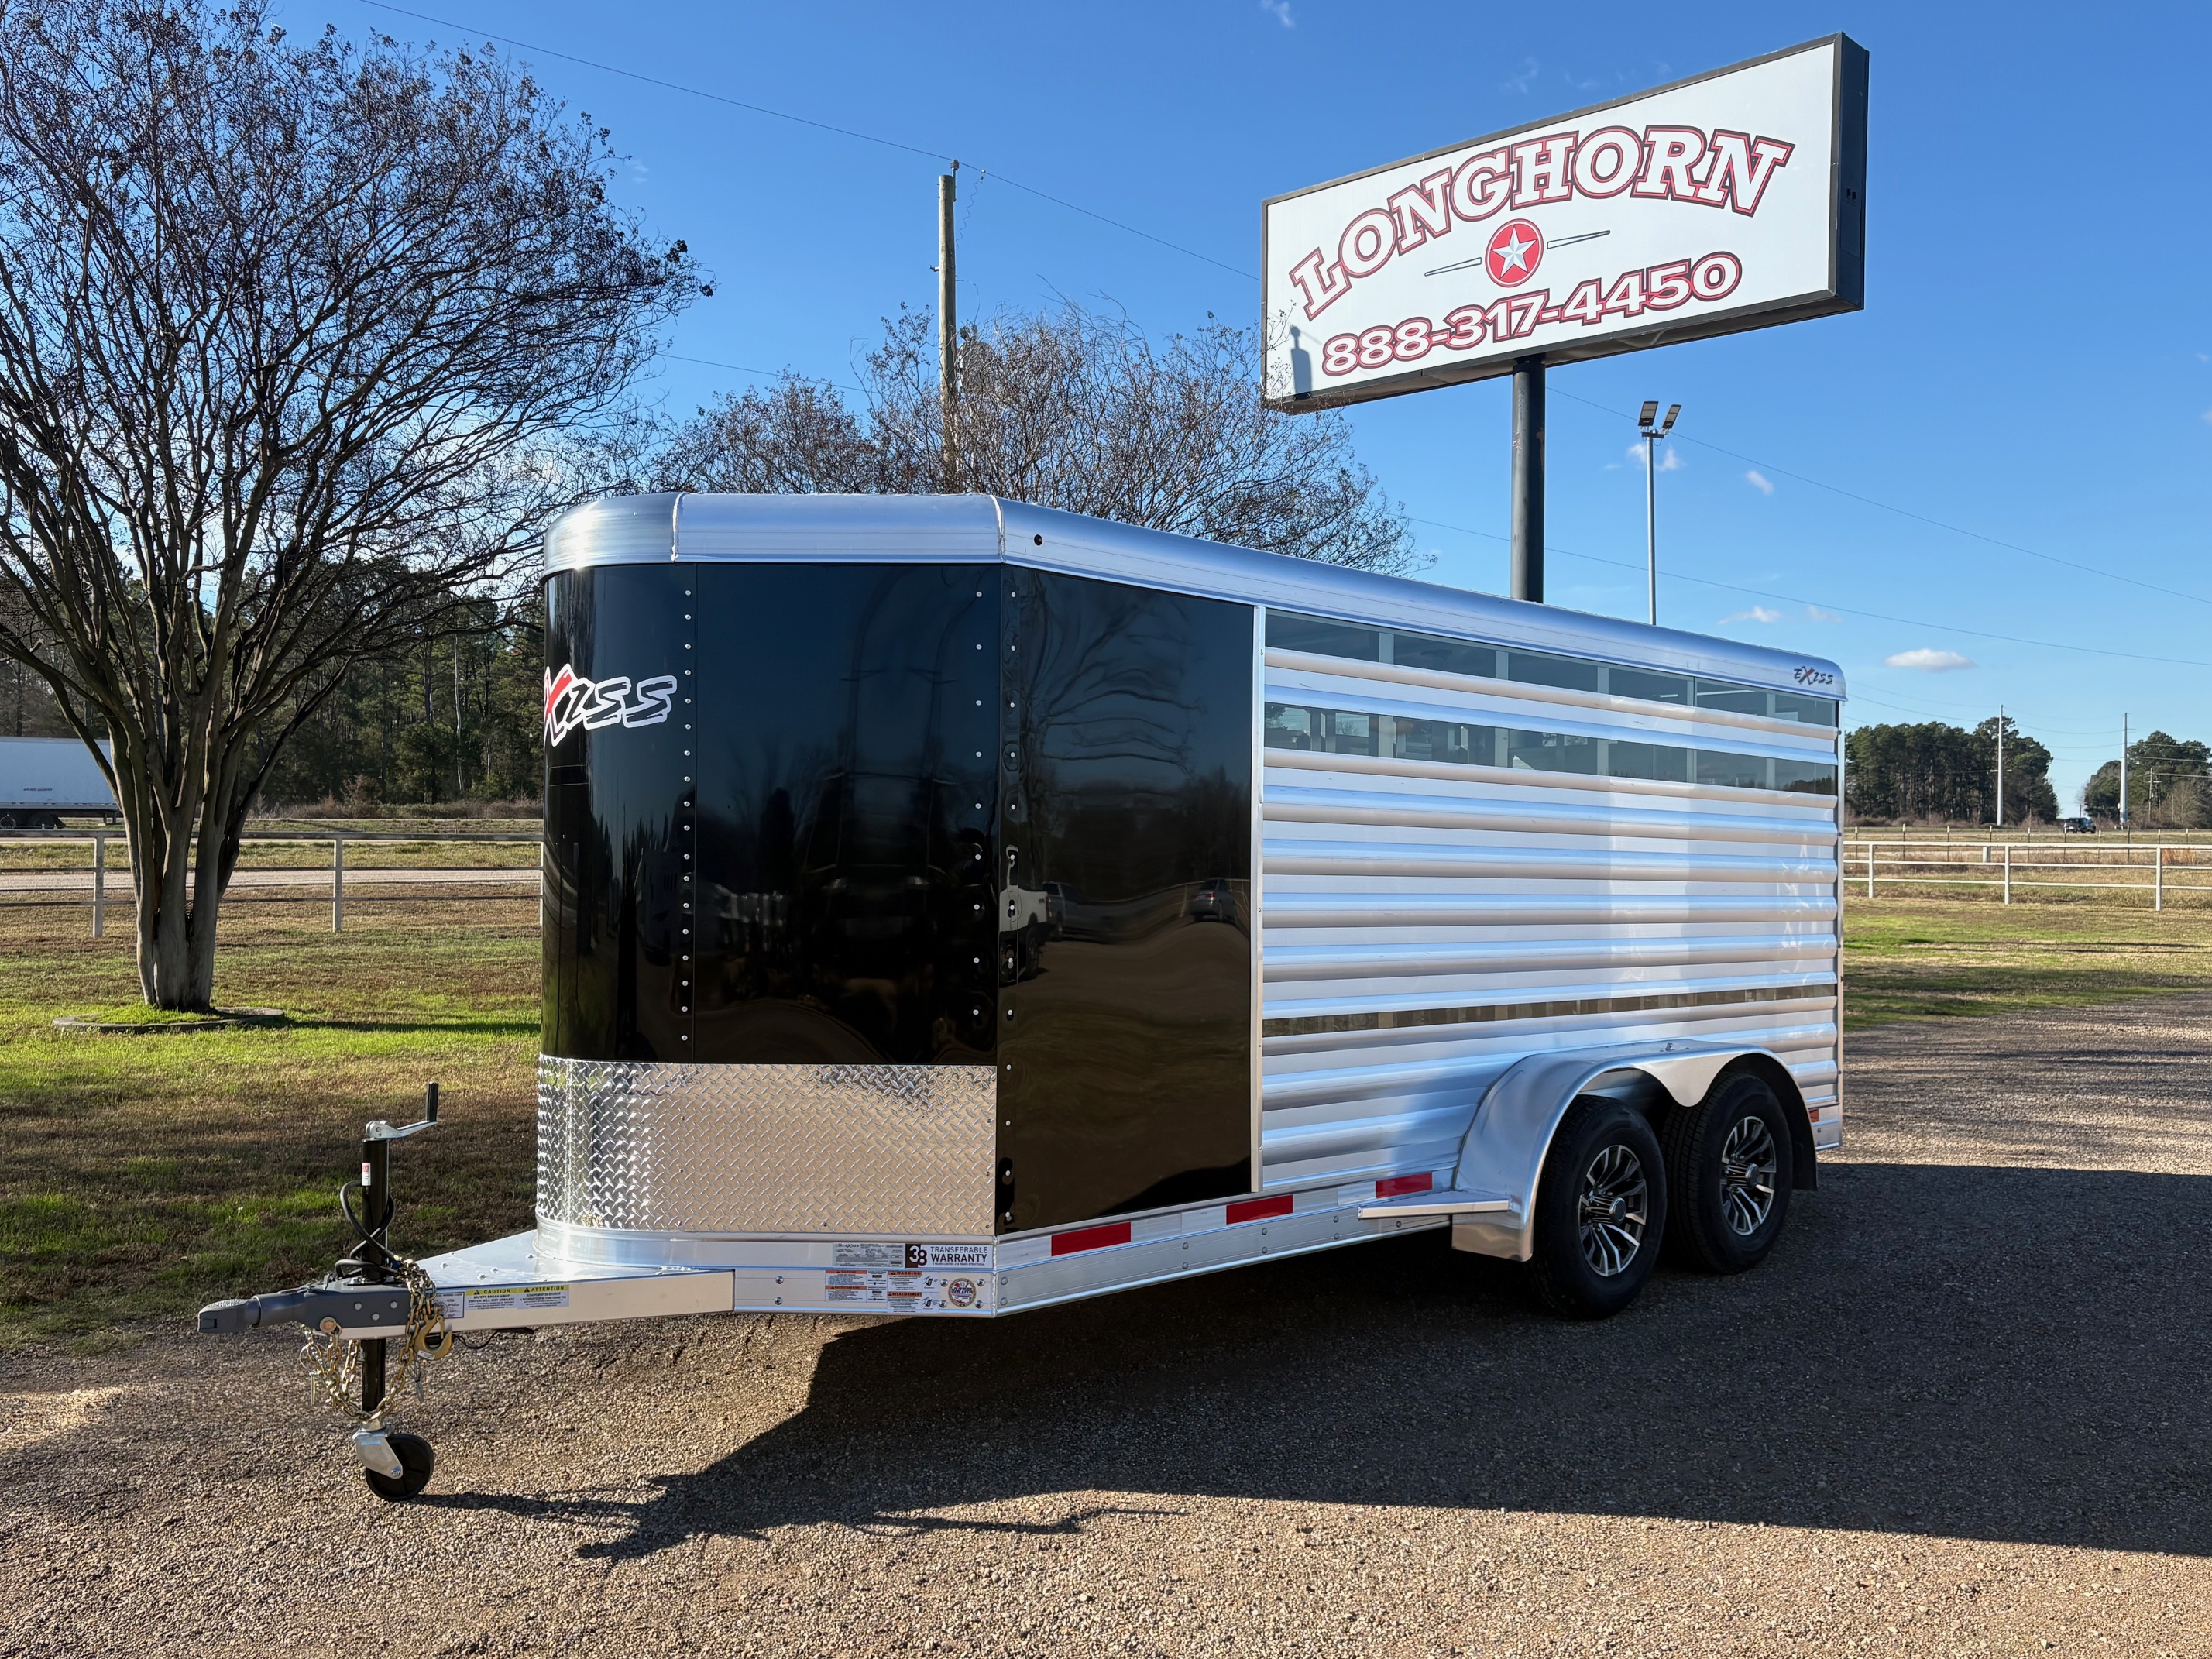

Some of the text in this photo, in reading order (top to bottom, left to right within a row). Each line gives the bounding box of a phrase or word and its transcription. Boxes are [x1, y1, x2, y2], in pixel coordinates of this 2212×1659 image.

[1289, 125, 1795, 321] LONGHORN
[1322, 251, 1743, 376] 888-317-4450
[930, 1253, 988, 1262] WARRANTY
